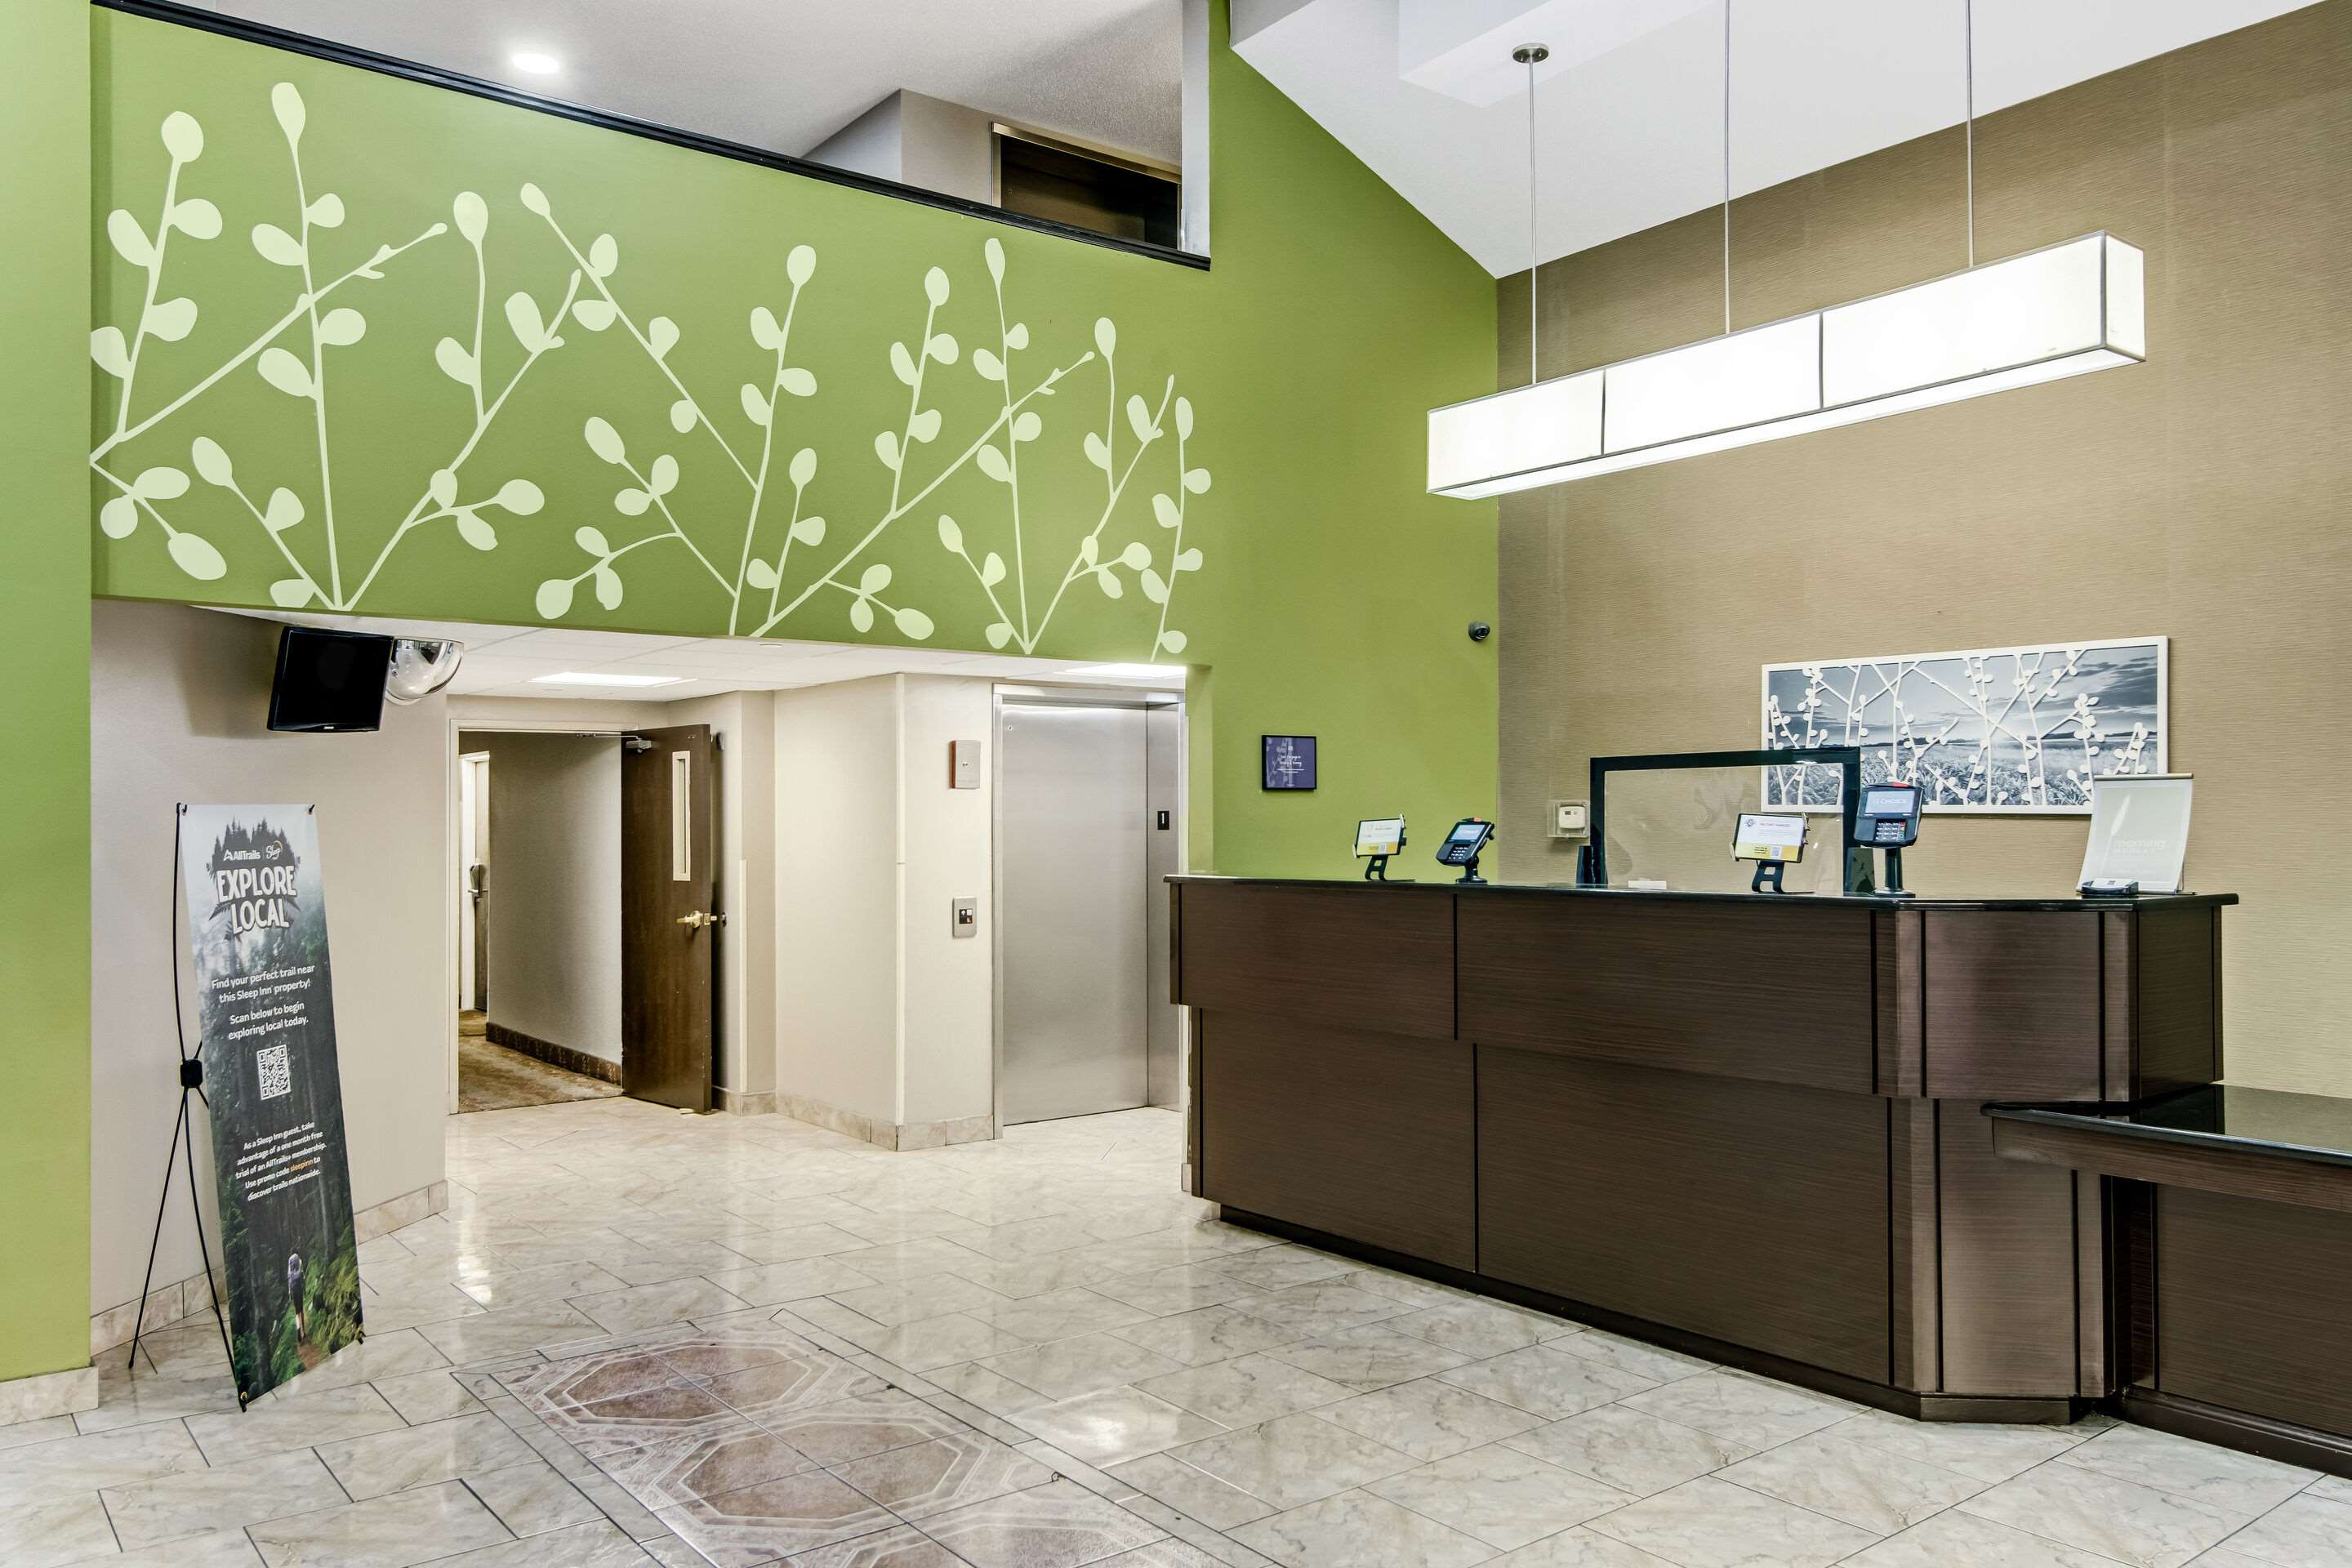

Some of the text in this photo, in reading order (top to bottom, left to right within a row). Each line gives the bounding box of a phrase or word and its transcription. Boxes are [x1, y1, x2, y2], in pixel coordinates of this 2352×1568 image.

[234, 849, 261, 861] AllTrails
[216, 865, 297, 902] EXPLORE
[230, 898, 290, 934] LOCAL
[212, 964, 315, 989] Find your perfect trail near
[219, 991, 236, 1003] this
[237, 988, 258, 1000] Sleep
[274, 978, 310, 995] property!
[229, 1000, 305, 1025] Scan below to begin
[229, 1015, 309, 1040] exploring local today.
[237, 1150, 270, 1165] advantage
[270, 1145, 277, 1155] of
[281, 1142, 292, 1151] one
[292, 1134, 311, 1147] month
[310, 1131, 323, 1141] free
[256, 1135, 274, 1146] Sleep
[274, 1132, 283, 1141] Inn
[235, 1168, 250, 1179] trial
[250, 1164, 258, 1174] of
[292, 1143, 327, 1159] membership.
[245, 1179, 257, 1189] Use
[257, 1173, 276, 1186] promo
[276, 1167, 290, 1177] code
[290, 1159, 314, 1172] sleepinn
[247, 1169, 321, 1201] discover trails nationwide.
